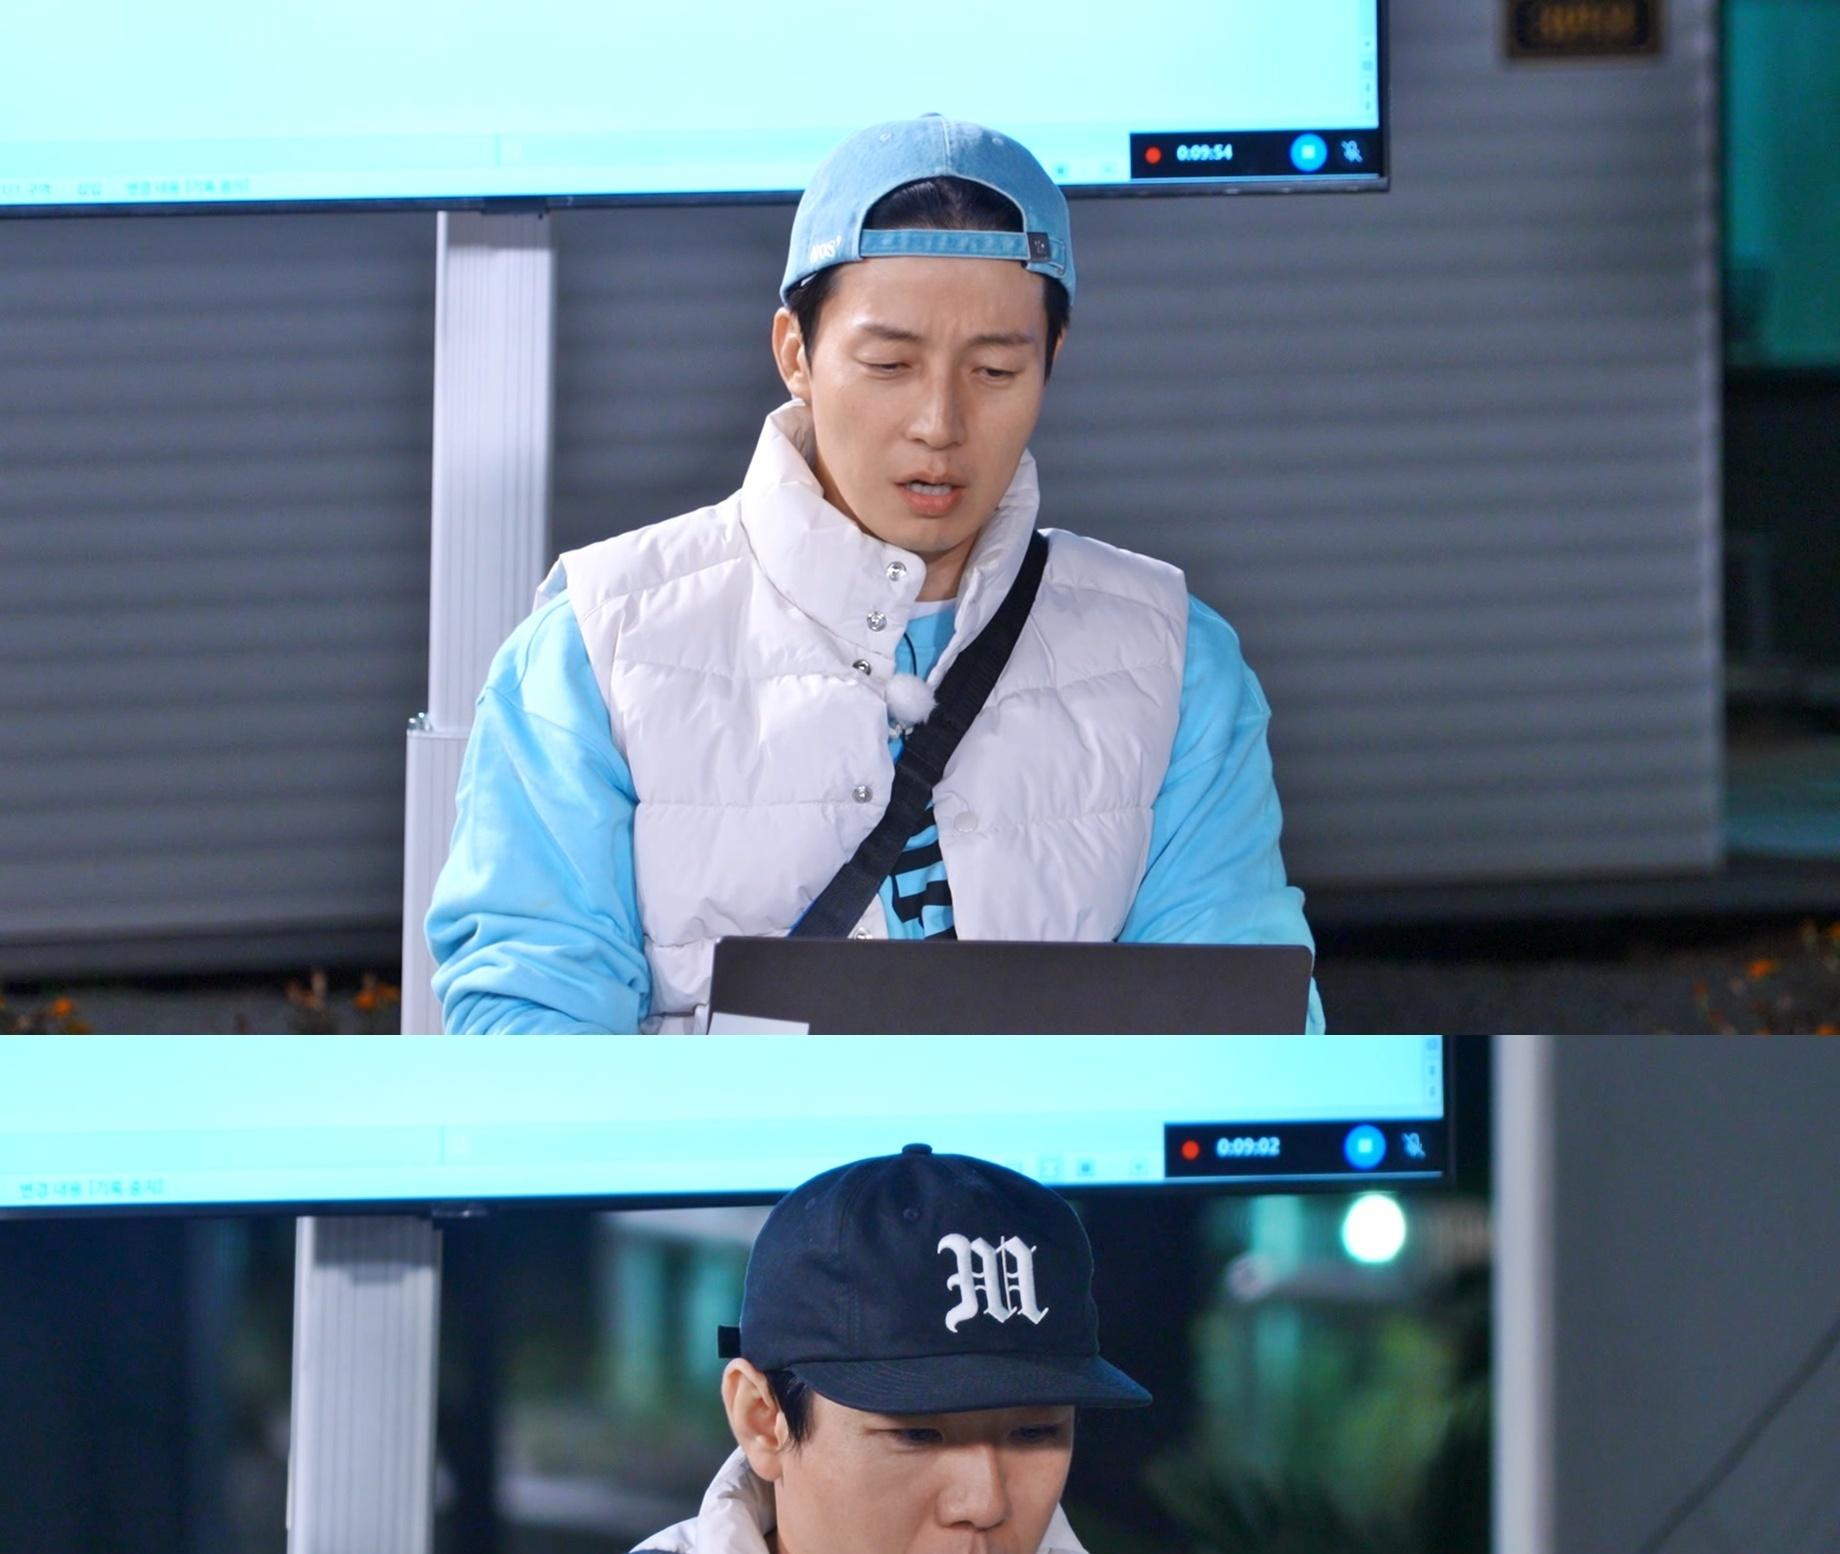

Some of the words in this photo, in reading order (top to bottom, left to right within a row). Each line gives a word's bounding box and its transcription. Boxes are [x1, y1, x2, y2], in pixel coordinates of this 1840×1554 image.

[1176, 143, 1233, 161] 0:09:54
[1216, 1137, 1280, 1157] 0:09:02
[937, 1233, 1049, 1333] M
